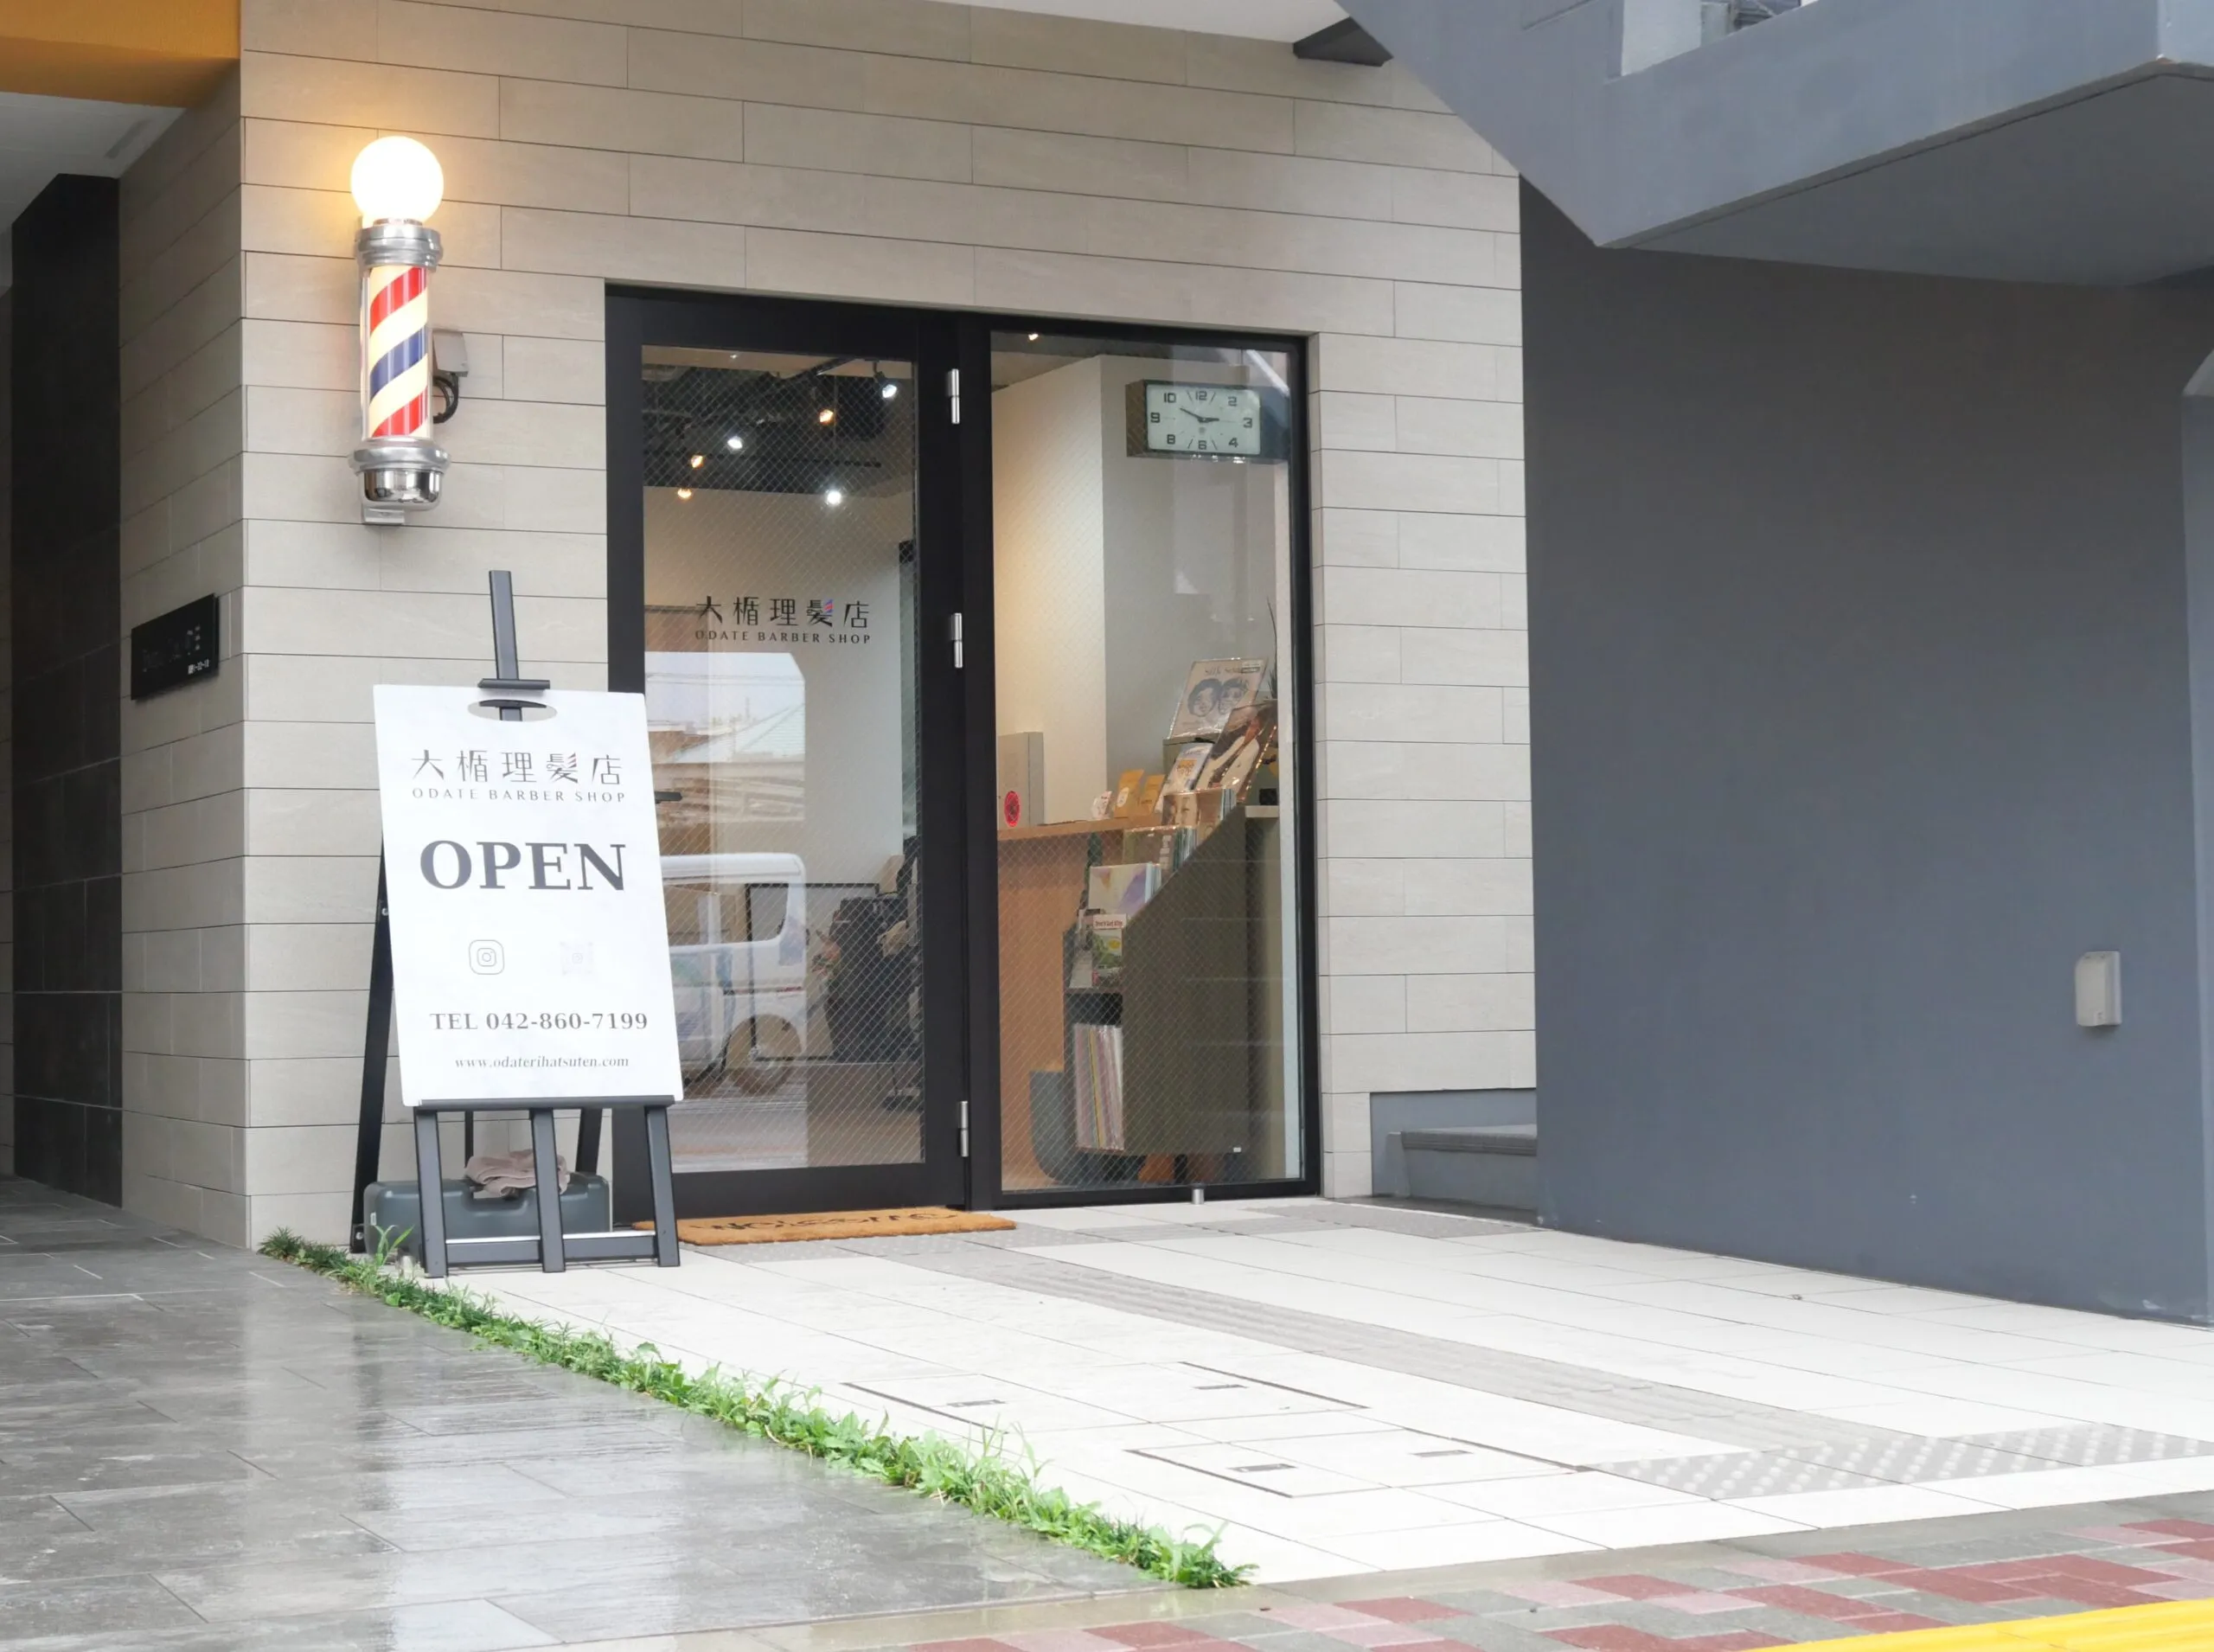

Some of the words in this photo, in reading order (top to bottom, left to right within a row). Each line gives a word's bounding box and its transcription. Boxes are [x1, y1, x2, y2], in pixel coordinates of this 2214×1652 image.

[1163, 393, 1176, 403] 10
[1195, 391, 1207, 401] 12
[1228, 397, 1238, 407] 2
[1150, 413, 1161, 423] 9
[1243, 418, 1253, 428] 3
[1167, 434, 1175, 445] 8
[1229, 438, 1238, 447] 4
[1198, 440, 1207, 450] 6
[694, 630, 749, 642] ODATE
[758, 631, 820, 643] BARBER
[829, 633, 871, 644] SHOP
[412, 787, 478, 800] ODATE
[489, 789, 565, 802] BARBER
[574, 791, 625, 803] SHOP
[420, 840, 626, 891] OPEN
[429, 1013, 477, 1030] TEL
[486, 1012, 648, 1030] 042-860-7199
[455, 1056, 630, 1069] www.odaterihatsuten.com
